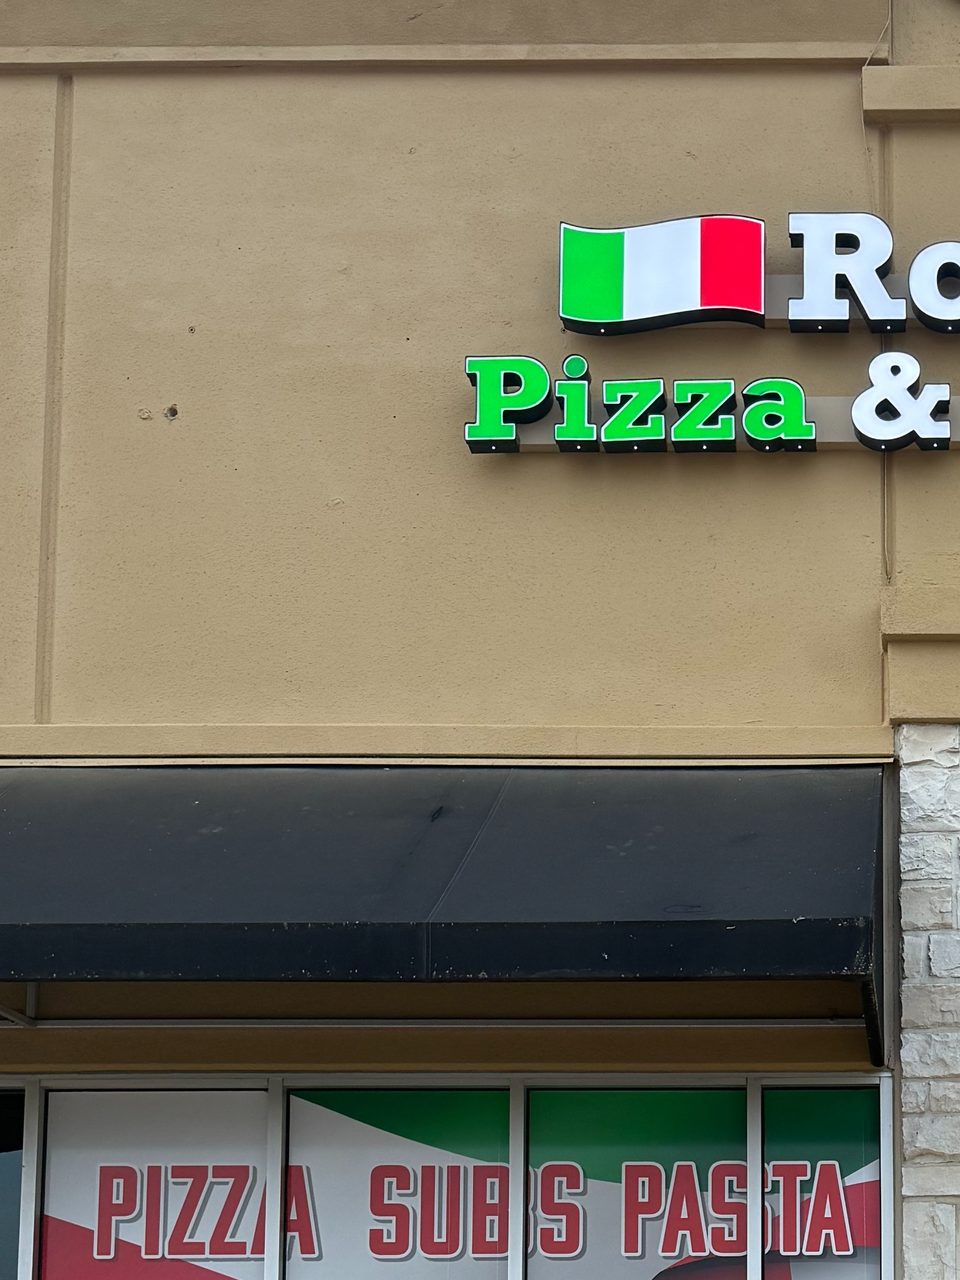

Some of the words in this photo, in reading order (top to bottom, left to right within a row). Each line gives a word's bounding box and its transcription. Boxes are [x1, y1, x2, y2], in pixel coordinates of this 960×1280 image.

[464, 354, 817, 442] Pizza
[851, 351, 951, 442] &
[94, 1163, 320, 1261] PIZZA
[368, 1162, 585, 1260] SUBS
[621, 1159, 855, 1258] PASTA
